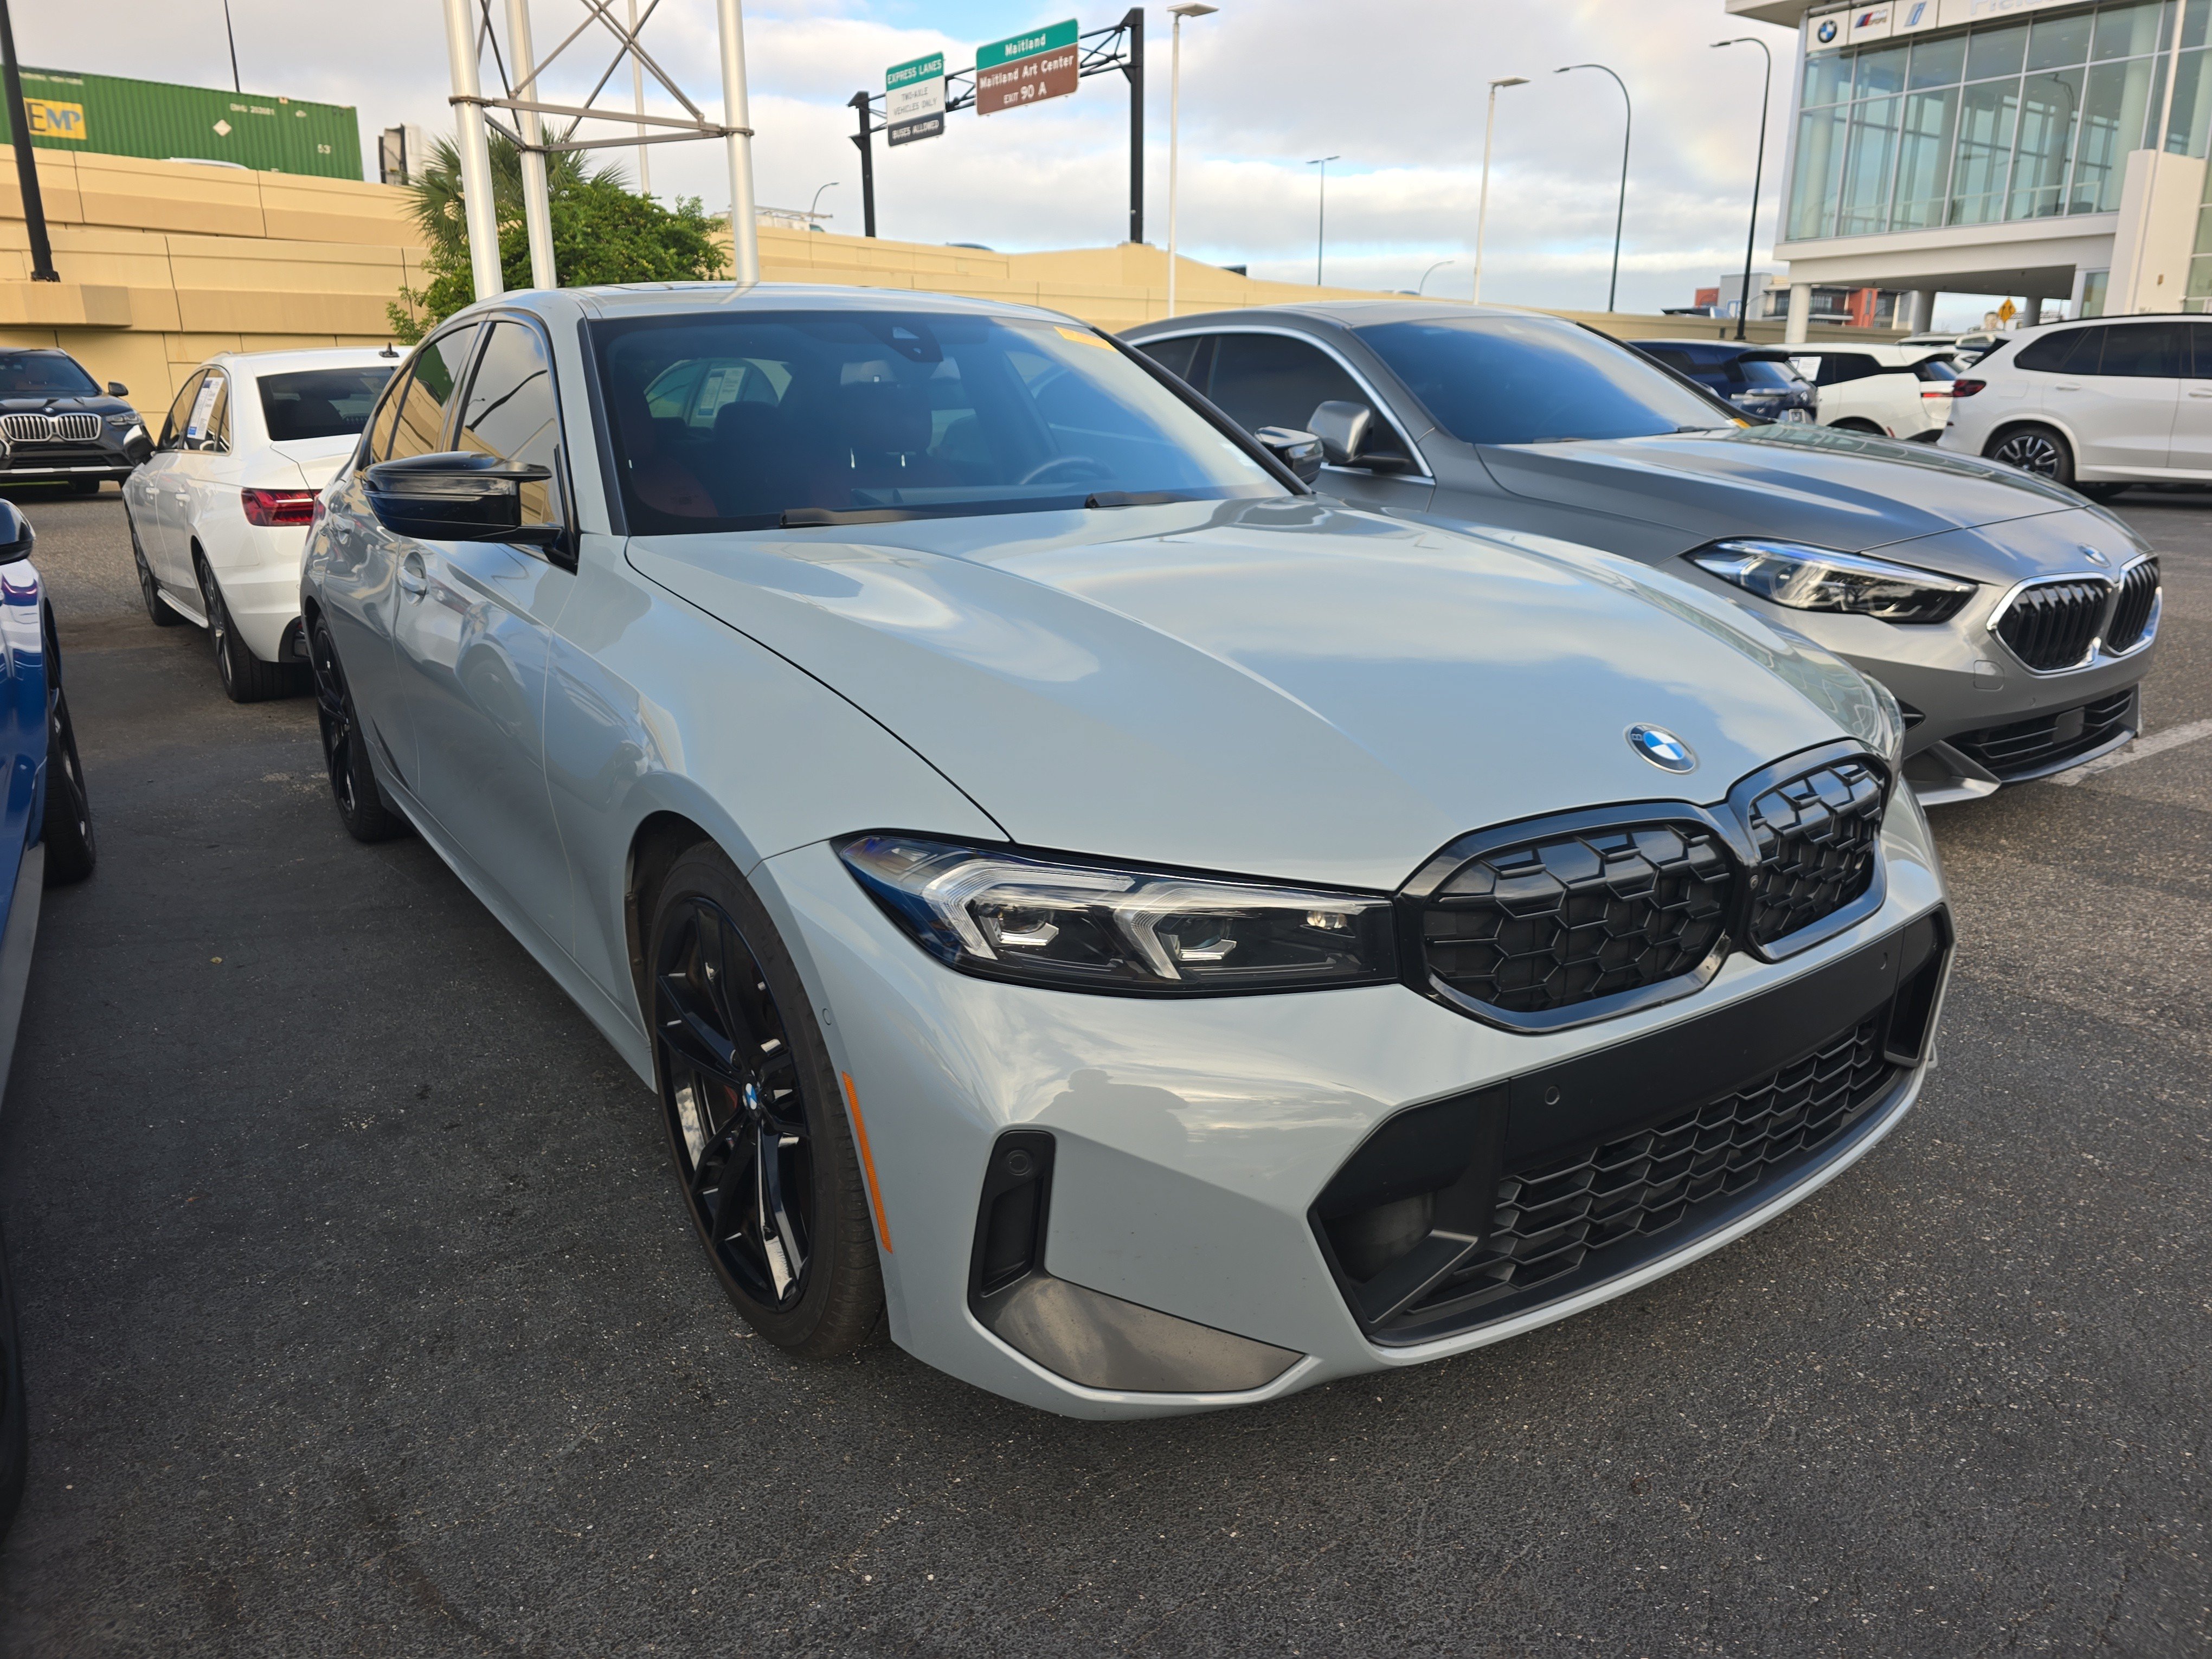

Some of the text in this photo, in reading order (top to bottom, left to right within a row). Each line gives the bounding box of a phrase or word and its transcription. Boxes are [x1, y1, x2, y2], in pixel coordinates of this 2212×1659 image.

[1005, 33, 1046, 56] Maitland
[888, 59, 942, 84] EXPRESS LANES
[979, 55, 1074, 89] Maitland Art Center
[1004, 81, 1047, 104] EXIT 90 A
[893, 97, 937, 115] VEHICLES ONLY
[892, 119, 939, 139] BUSES ALLOWED
